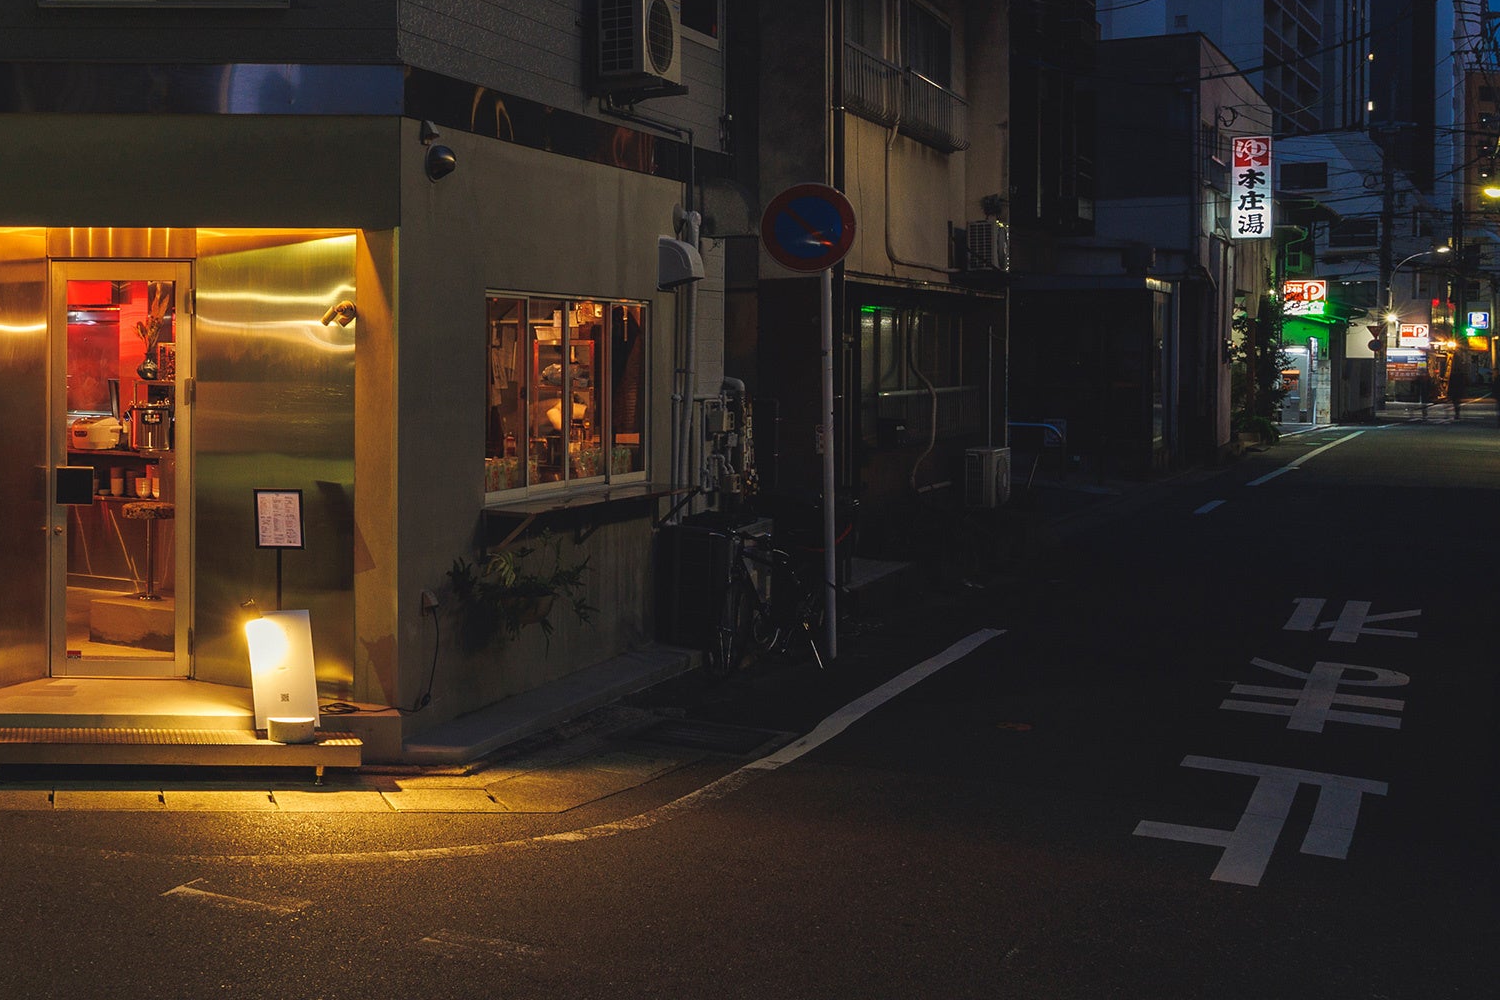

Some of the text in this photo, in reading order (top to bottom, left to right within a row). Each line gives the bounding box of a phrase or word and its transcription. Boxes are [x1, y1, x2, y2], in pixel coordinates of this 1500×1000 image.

[1235, 140, 1267, 166] ゆ
[1238, 168, 1266, 234] 本庄湯
[1132, 598, 1422, 887] 止まれ
